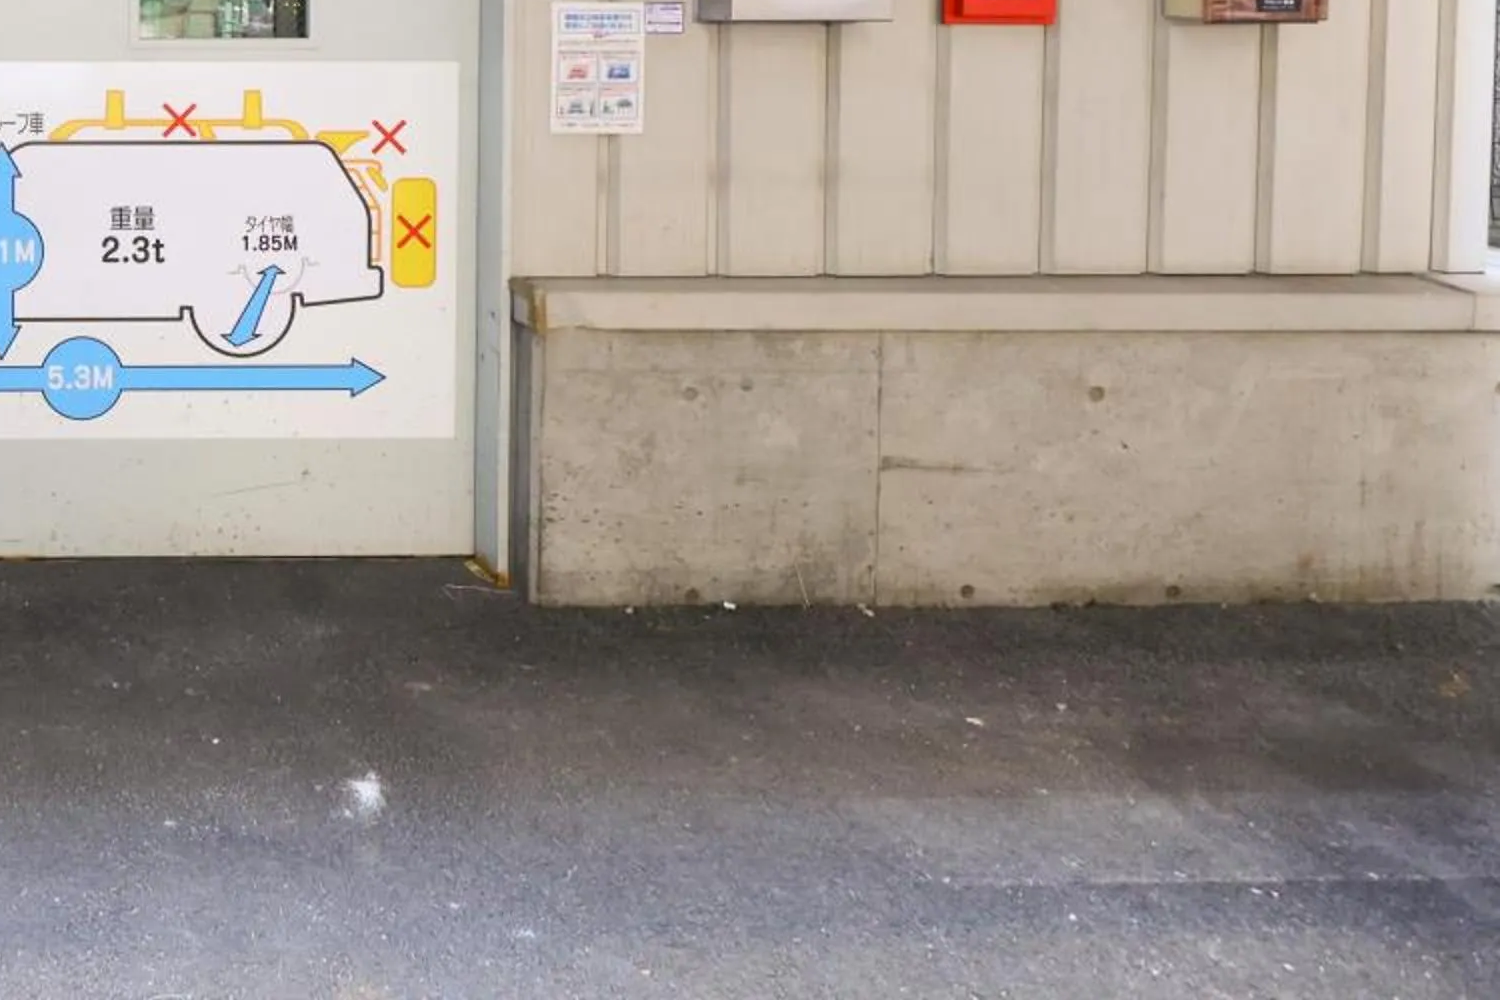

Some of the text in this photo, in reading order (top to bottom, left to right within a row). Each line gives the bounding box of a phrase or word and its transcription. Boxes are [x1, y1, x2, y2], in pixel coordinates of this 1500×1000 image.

[109, 206, 156, 231] 重量
[244, 215, 295, 234] タイヤ幅
[100, 236, 166, 264] 2.3t
[241, 235, 299, 252] 1.85M
[47, 364, 114, 391] 5.3M
